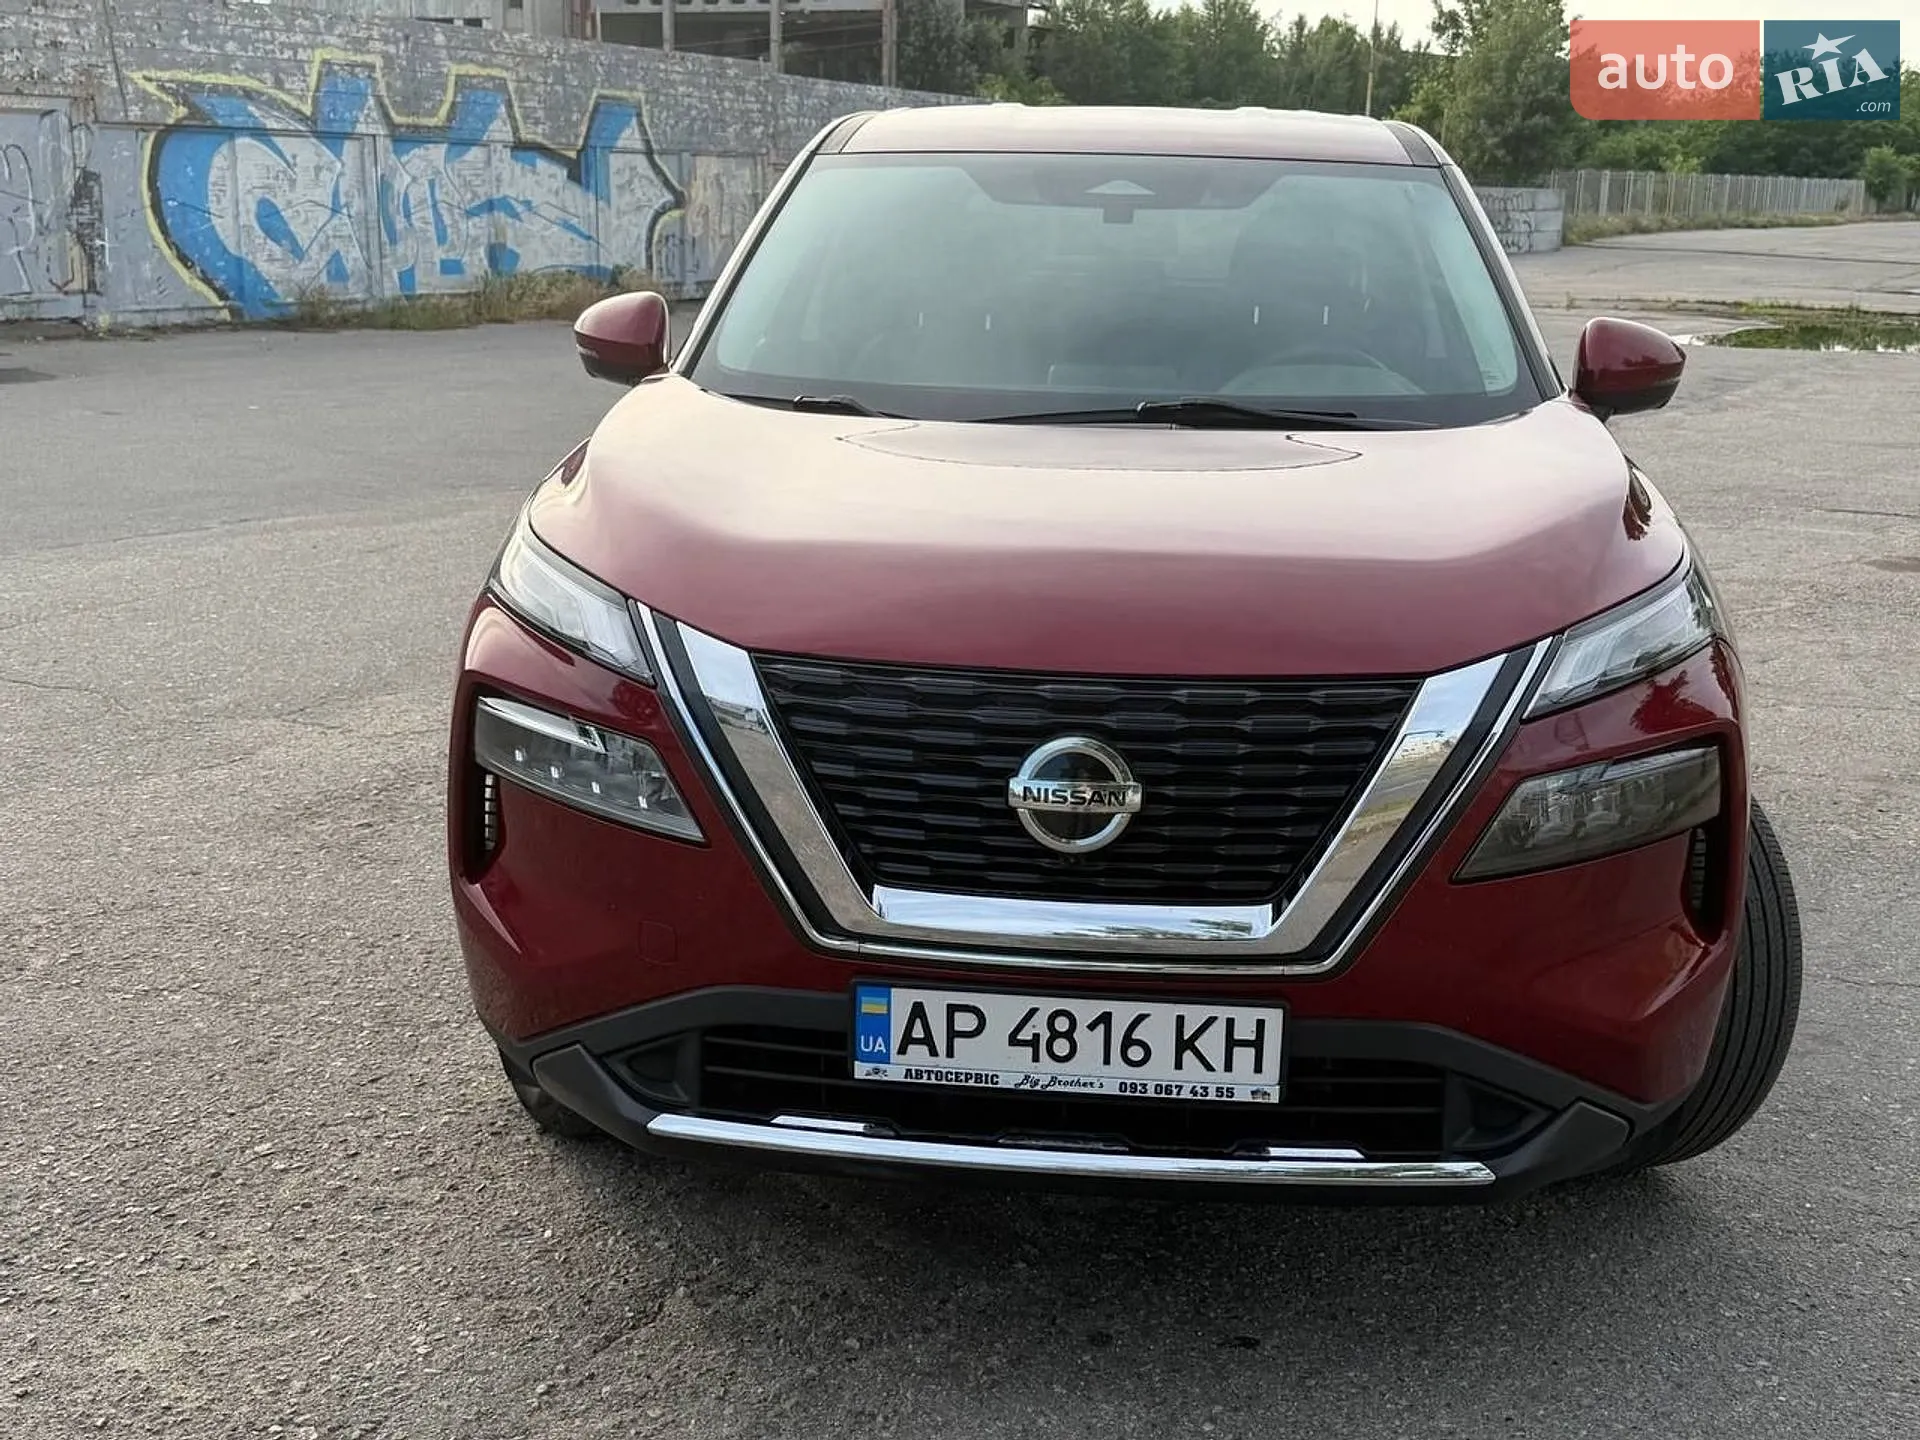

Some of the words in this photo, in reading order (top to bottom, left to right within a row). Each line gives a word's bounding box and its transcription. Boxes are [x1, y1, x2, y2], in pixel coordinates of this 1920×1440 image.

[1023, 787, 1126, 806] NISSAN
[860, 1035, 886, 1054] UA
[897, 1001, 987, 1058] AP
[1008, 1007, 1152, 1067] 4816
[1174, 1015, 1265, 1073] KH
[904, 1068, 999, 1086] АВТОСЕРВІС
[1014, 1074, 1040, 1090] Big
[1118, 1081, 1149, 1096] 093
[1153, 1083, 1185, 1098] 067
[1188, 1085, 1211, 1099] 43
[1214, 1086, 1236, 1100] 55
